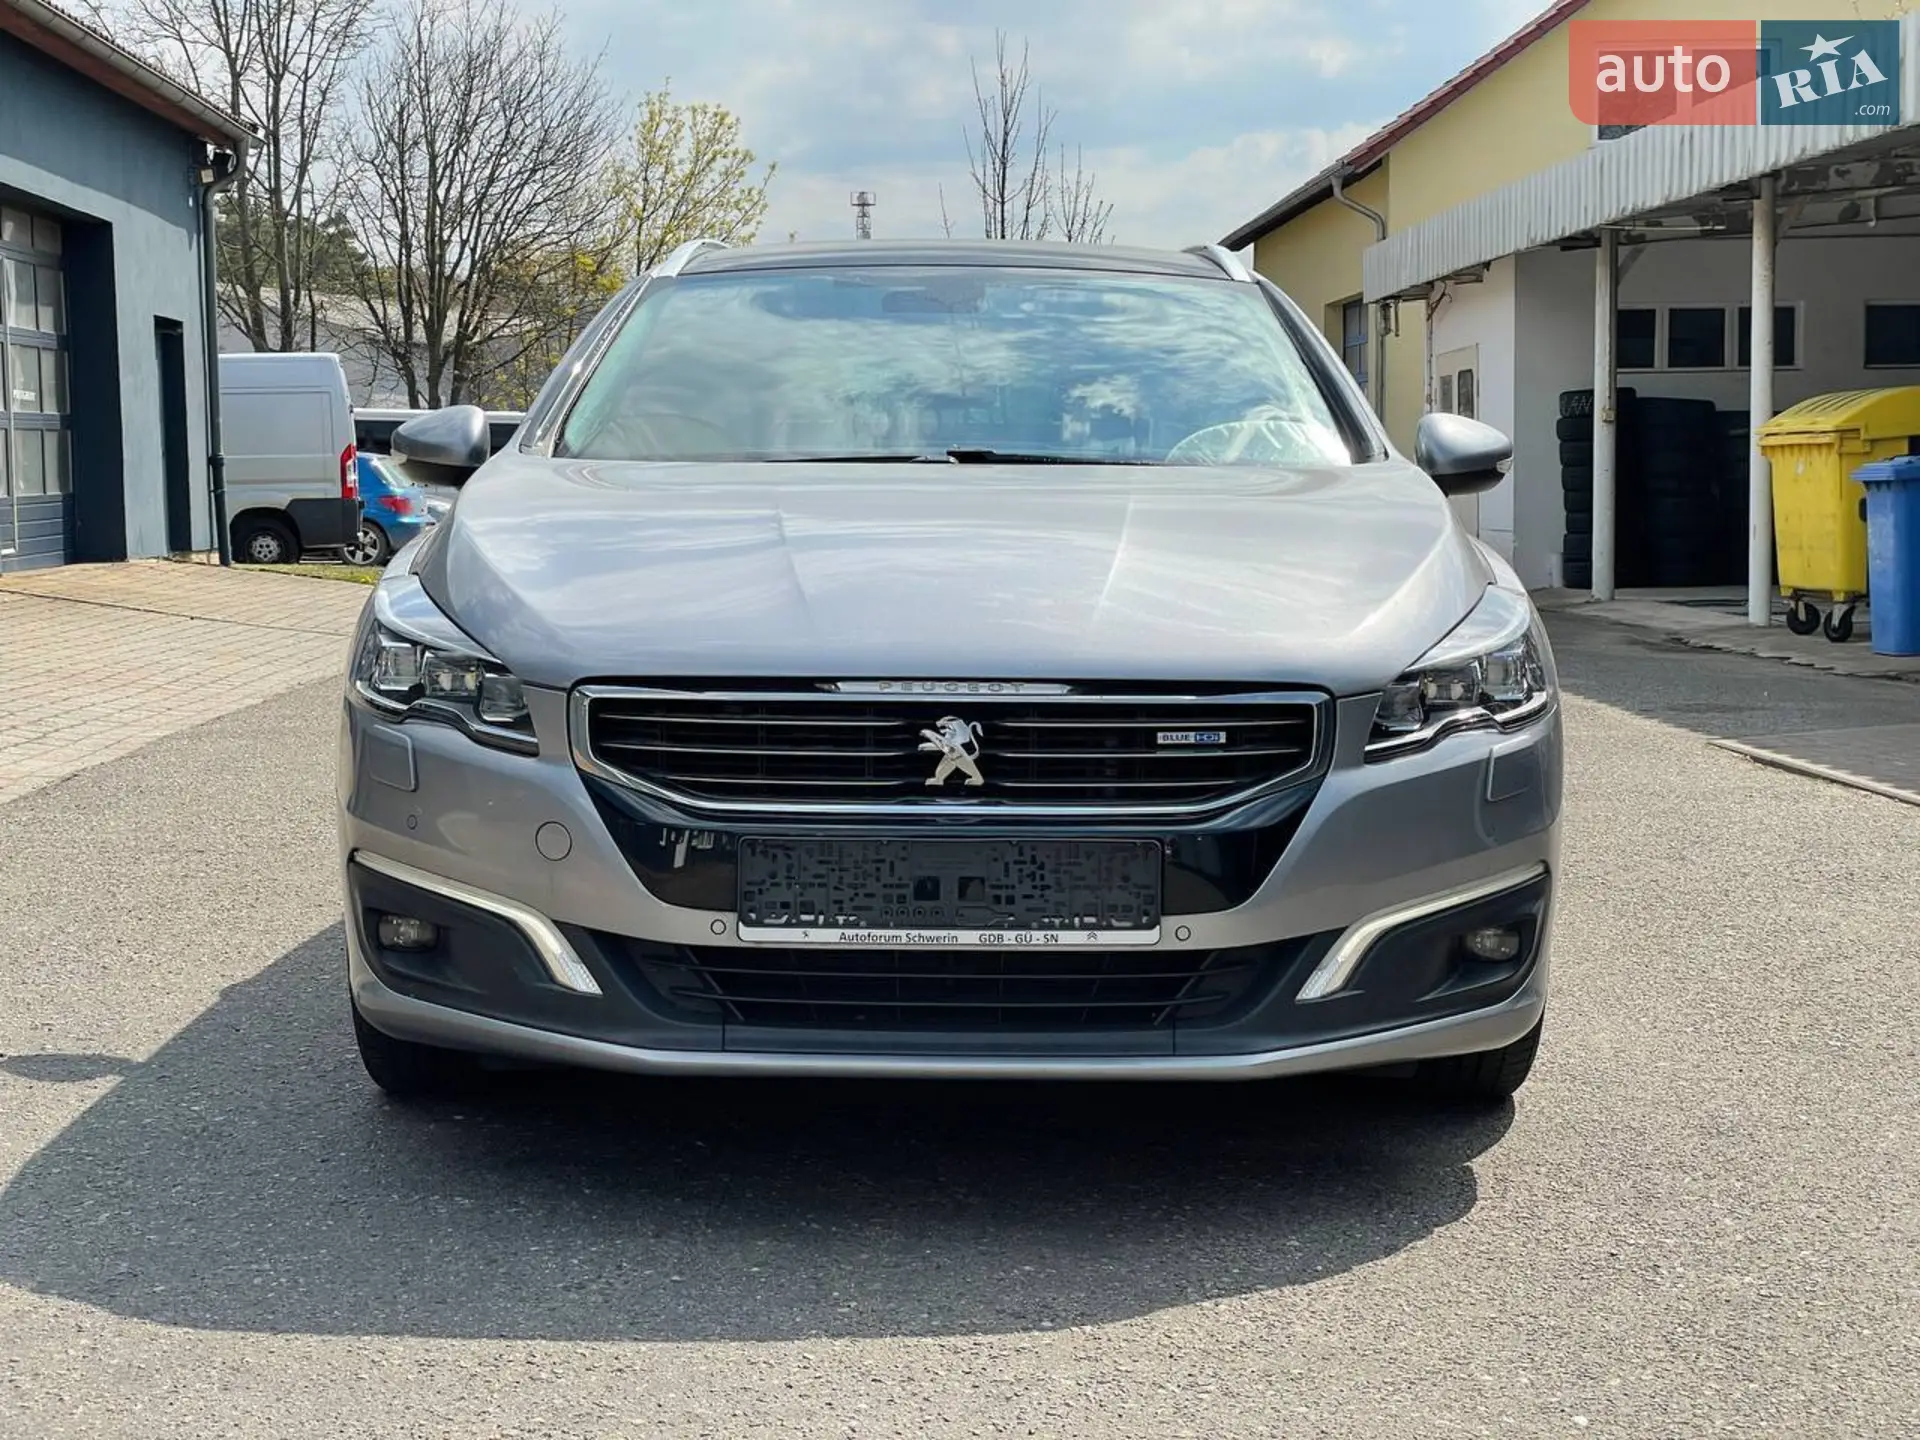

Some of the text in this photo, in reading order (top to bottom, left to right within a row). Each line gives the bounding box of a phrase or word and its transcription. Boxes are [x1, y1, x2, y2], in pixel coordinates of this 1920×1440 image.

[878, 682, 1025, 692] PEUGEOT
[1161, 733, 1190, 741] BLUE
[839, 931, 901, 943] Autoforum
[905, 932, 958, 944] Schwerin
[978, 933, 1003, 944] GDB
[1015, 931, 1032, 944] GÜ
[1044, 933, 1059, 944] SN
